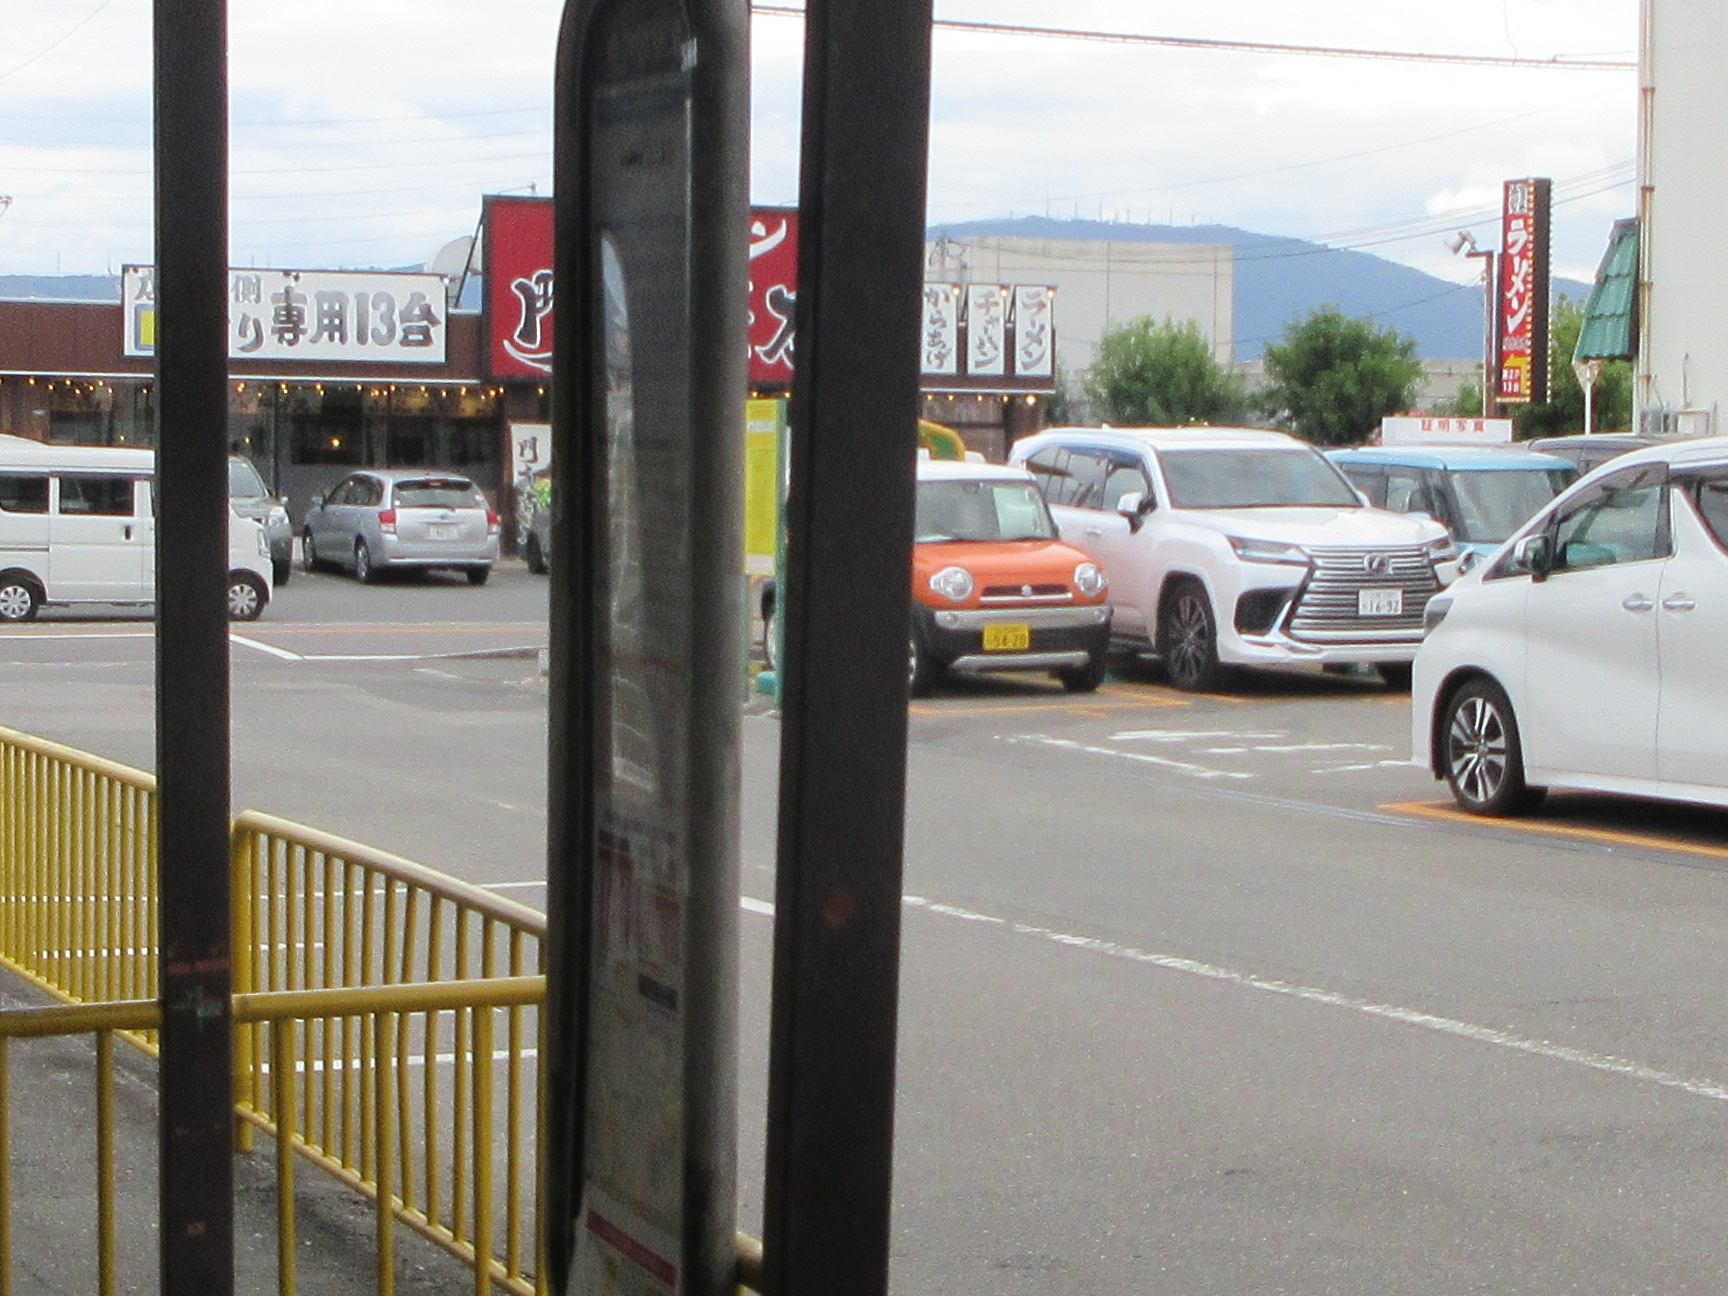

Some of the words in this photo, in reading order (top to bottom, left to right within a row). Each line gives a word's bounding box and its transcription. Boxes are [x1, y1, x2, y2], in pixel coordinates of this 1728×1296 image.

[1505, 218, 1530, 333] ラーメン
[922, 288, 952, 370] からあげ
[973, 290, 1000, 370] チャーハン
[1020, 290, 1047, 372] ラーメン
